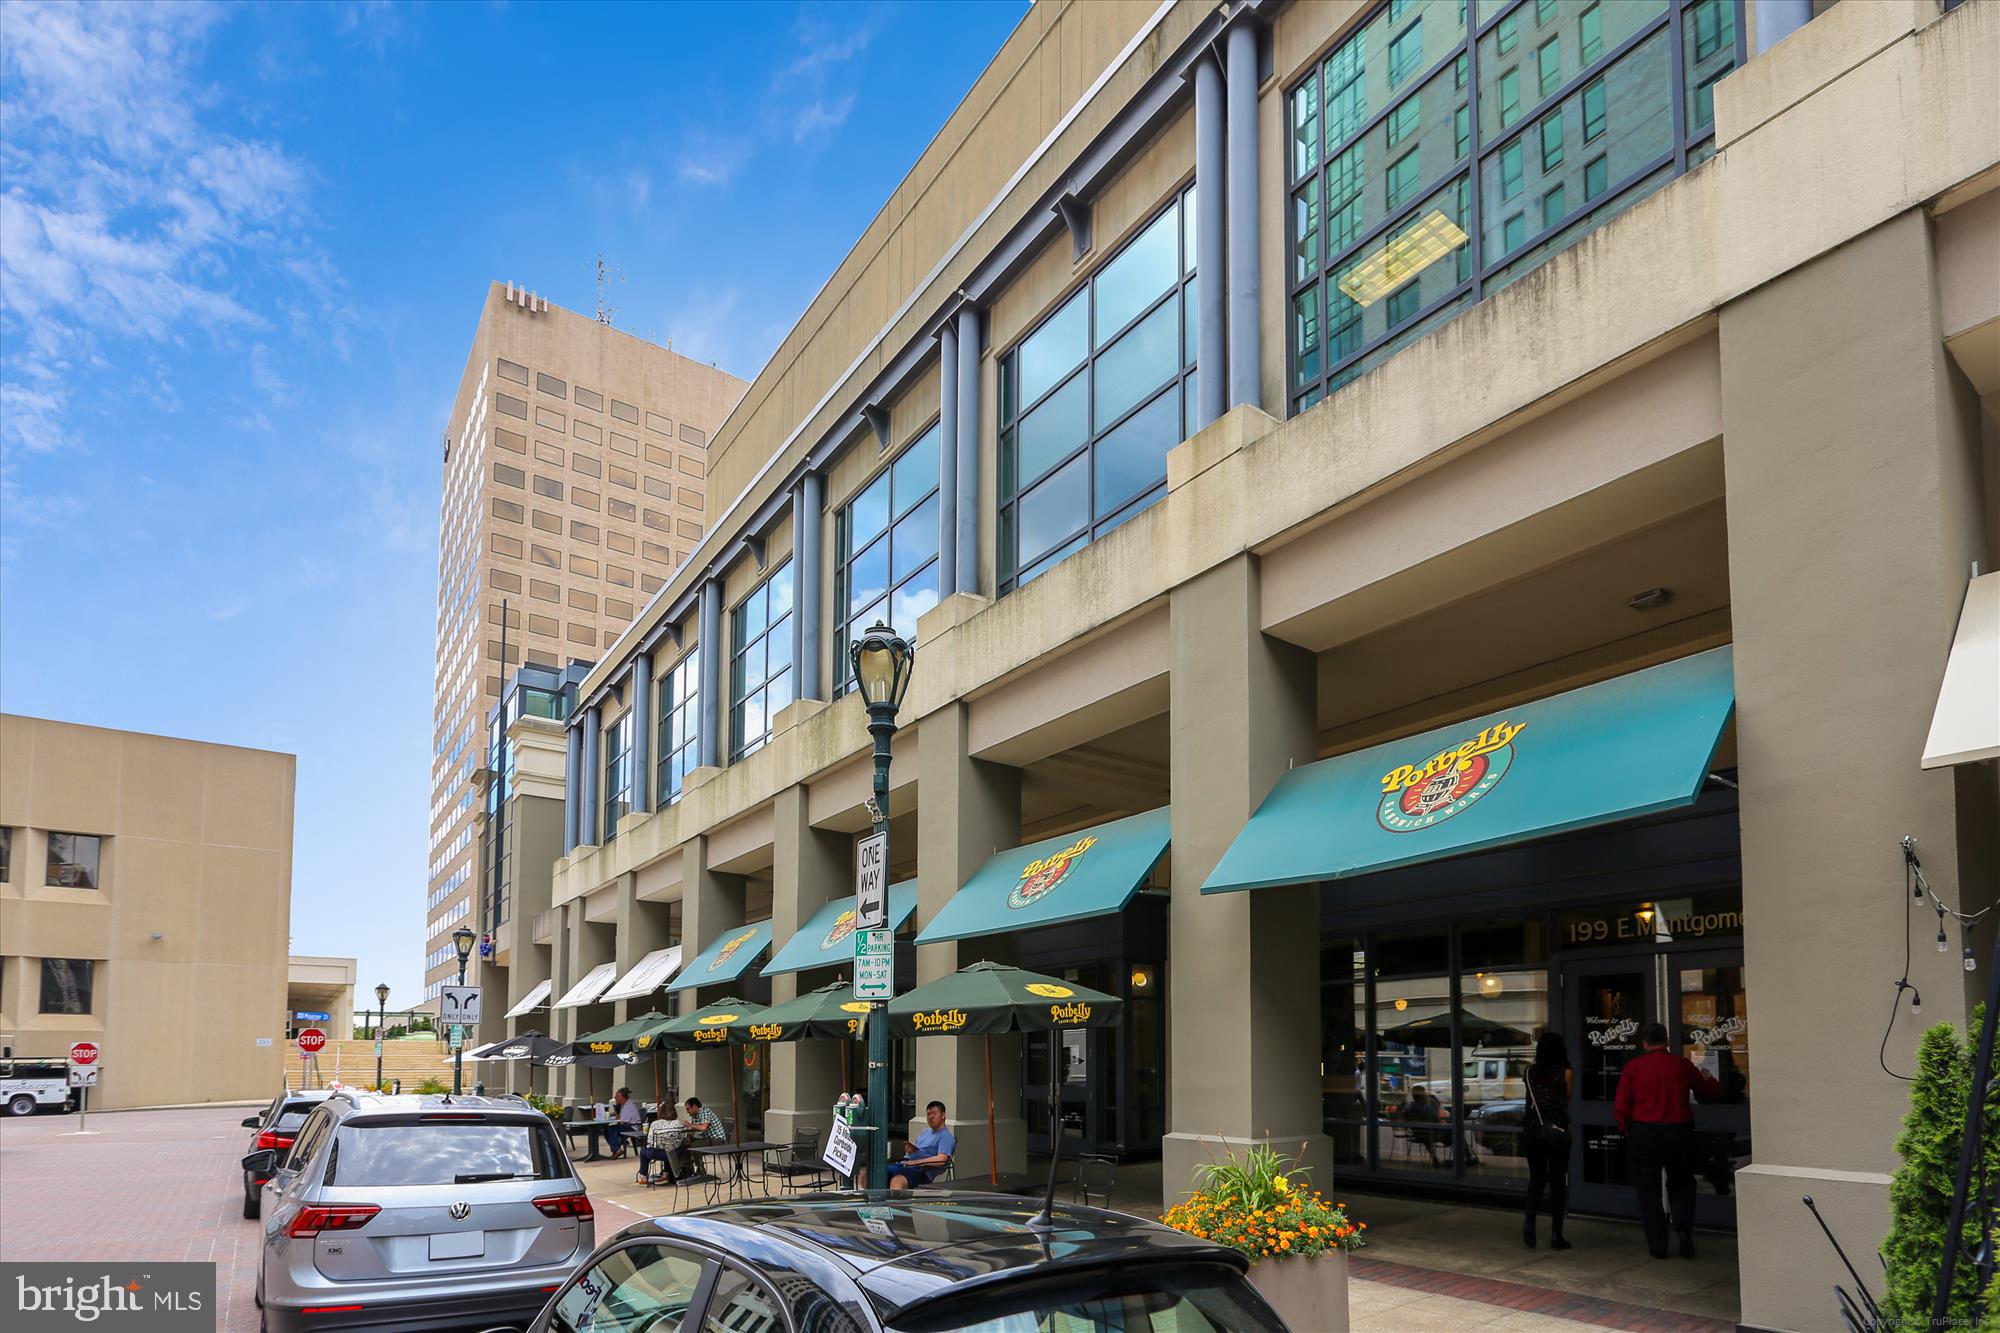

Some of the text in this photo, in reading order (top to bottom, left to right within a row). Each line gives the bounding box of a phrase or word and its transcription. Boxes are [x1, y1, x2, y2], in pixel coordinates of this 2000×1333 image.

[1381, 720, 1527, 793] Potbelly
[1384, 772, 1498, 828] SANDWICH WORKS
[862, 843, 881, 868] ONE
[1020, 834, 1098, 880] Potbelly
[860, 868, 881, 894] WAY
[874, 933, 884, 942] HR
[1569, 919, 1609, 943] 199
[868, 943, 890, 952] PARKING
[859, 970, 887, 980] MON-SAT
[912, 1008, 967, 1032] Potbelly
[1050, 1001, 1092, 1024] Potbelly
[300, 1035, 325, 1046] STOP
[693, 1027, 728, 1043] Potbell
[749, 1022, 783, 1041] Potbelly
[1587, 1018, 1640, 1046] Potbelly
[1689, 1016, 1748, 1044] Potbelly
[72, 1048, 97, 1058] STOP
